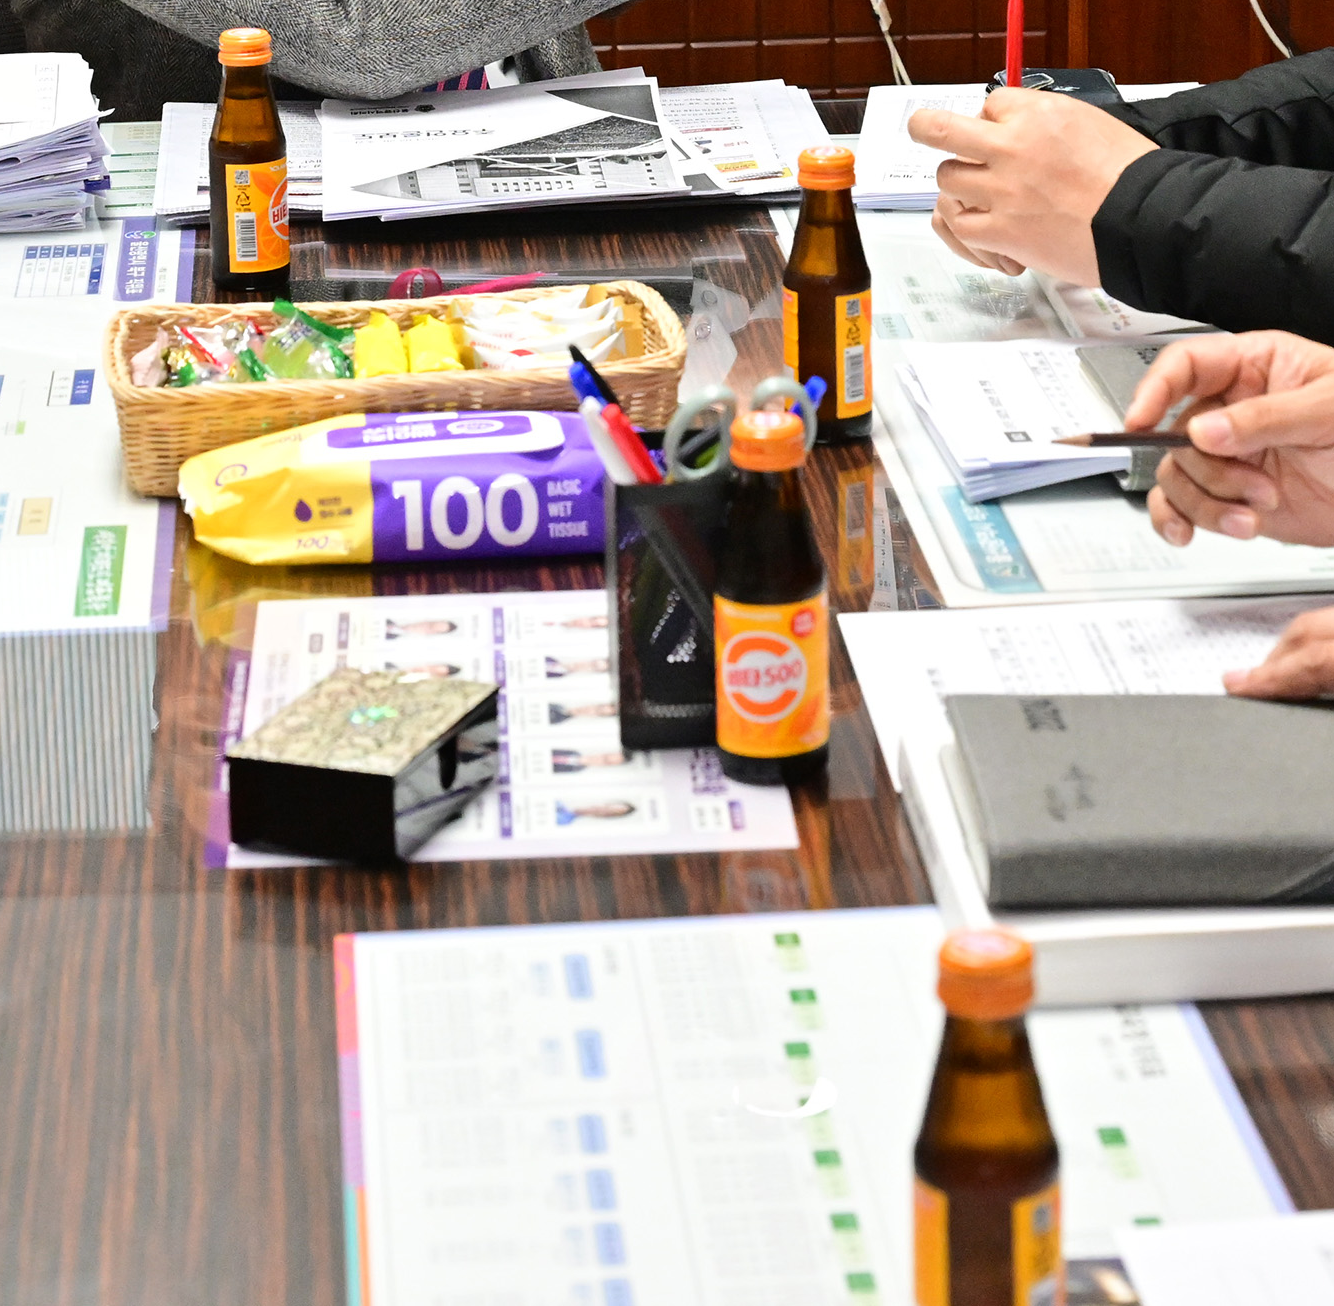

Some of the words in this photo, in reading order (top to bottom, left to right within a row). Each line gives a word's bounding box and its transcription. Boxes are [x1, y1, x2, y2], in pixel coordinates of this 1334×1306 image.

[547, 479, 583, 495] BASIC
[391, 472, 540, 551] 100
[547, 501, 573, 517] WET
[547, 523, 589, 538] TISSUE
